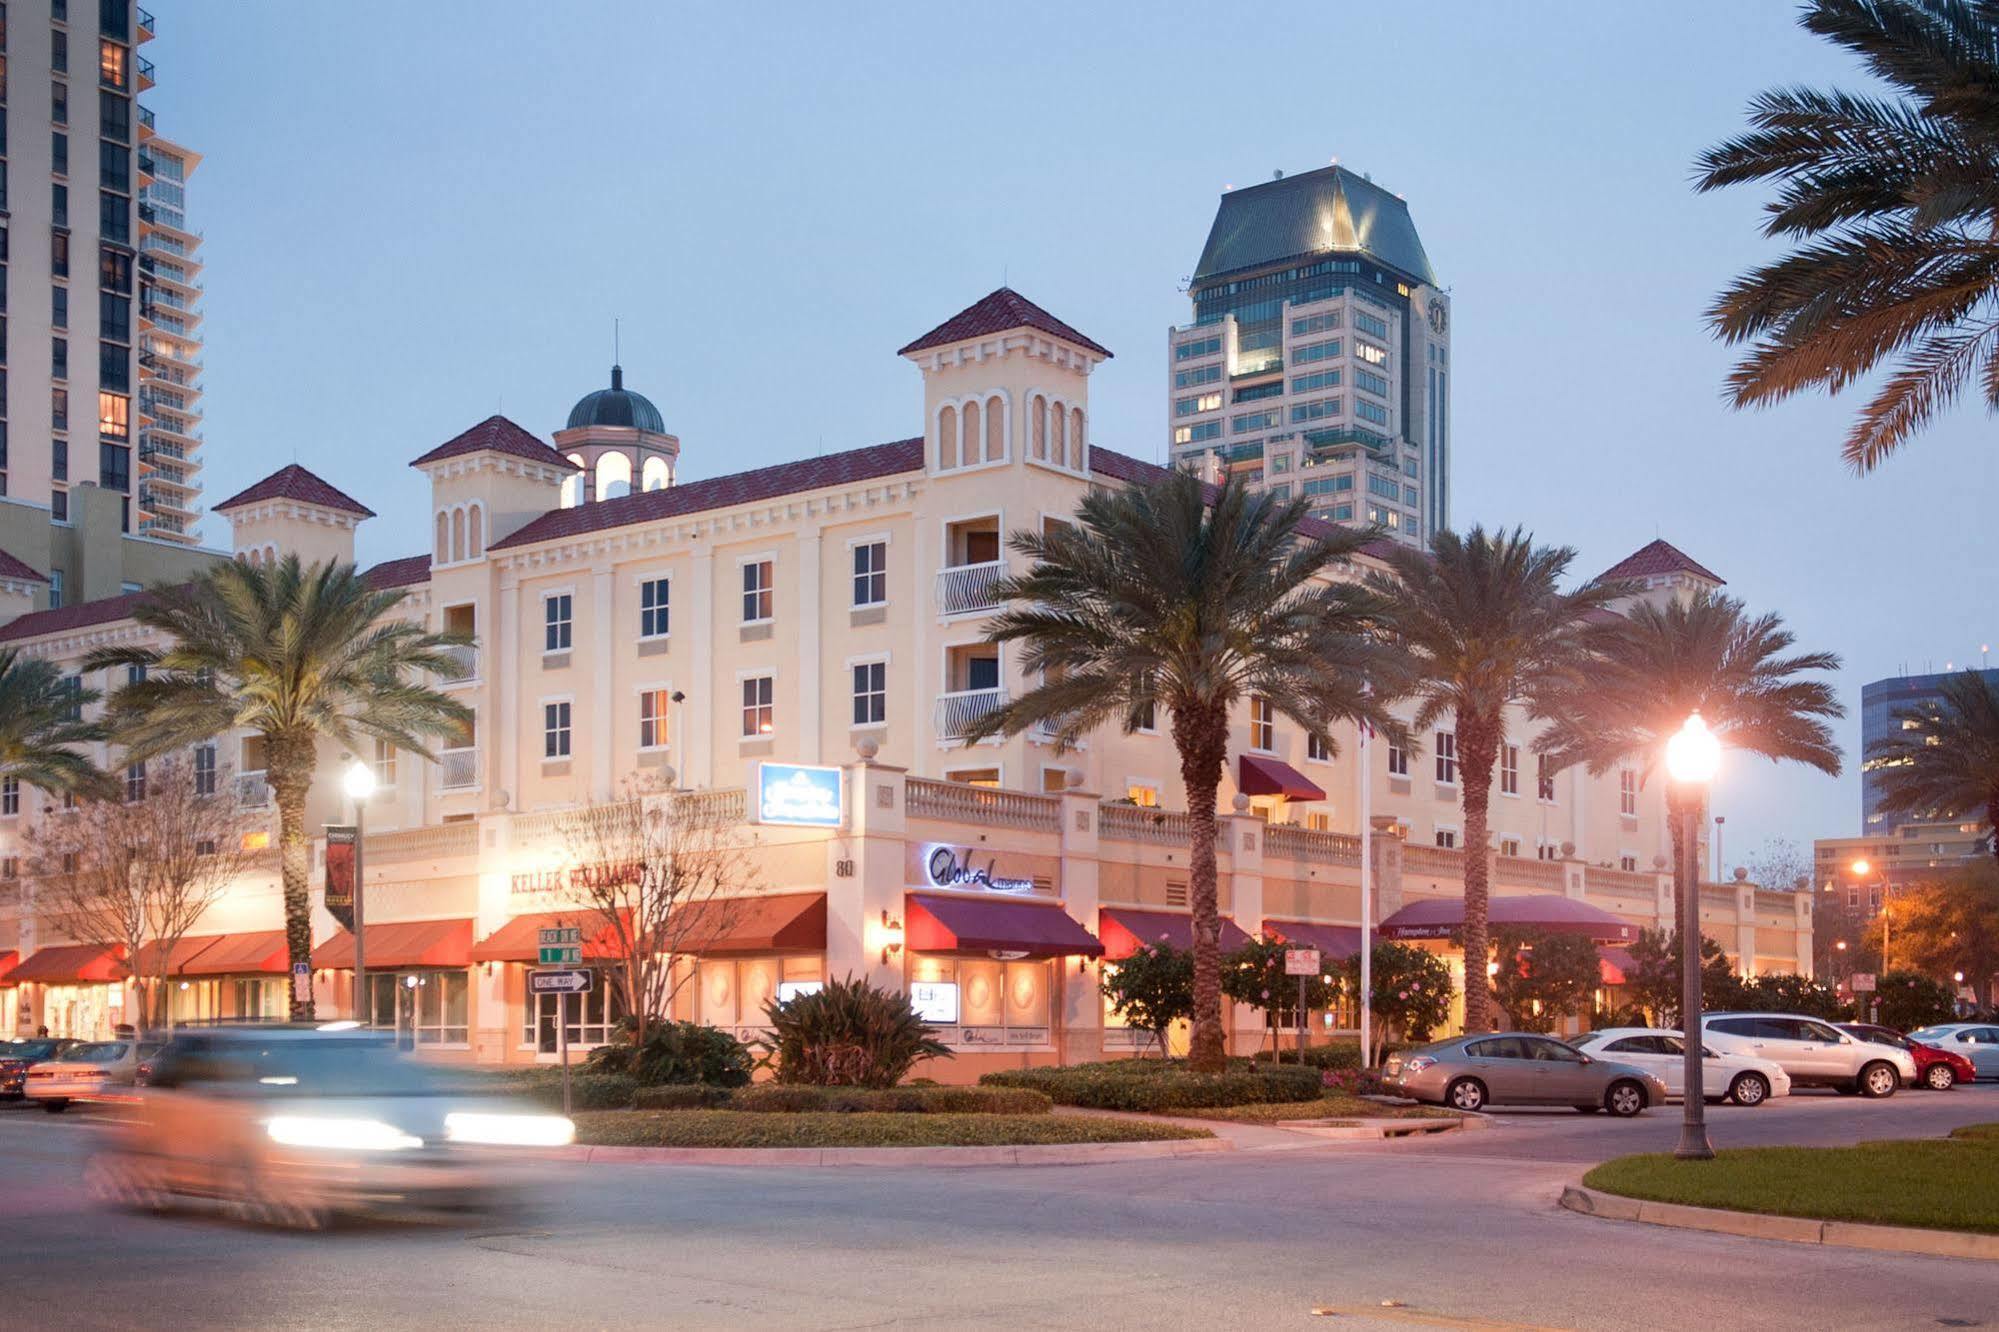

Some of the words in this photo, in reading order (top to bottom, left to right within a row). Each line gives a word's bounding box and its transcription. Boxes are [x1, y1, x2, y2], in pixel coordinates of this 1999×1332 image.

[836, 860, 854, 877] 80
[929, 847, 1014, 890] Global
[511, 871, 563, 894] KELLER
[537, 978, 553, 986] ONE
[557, 977, 573, 985] WAY
